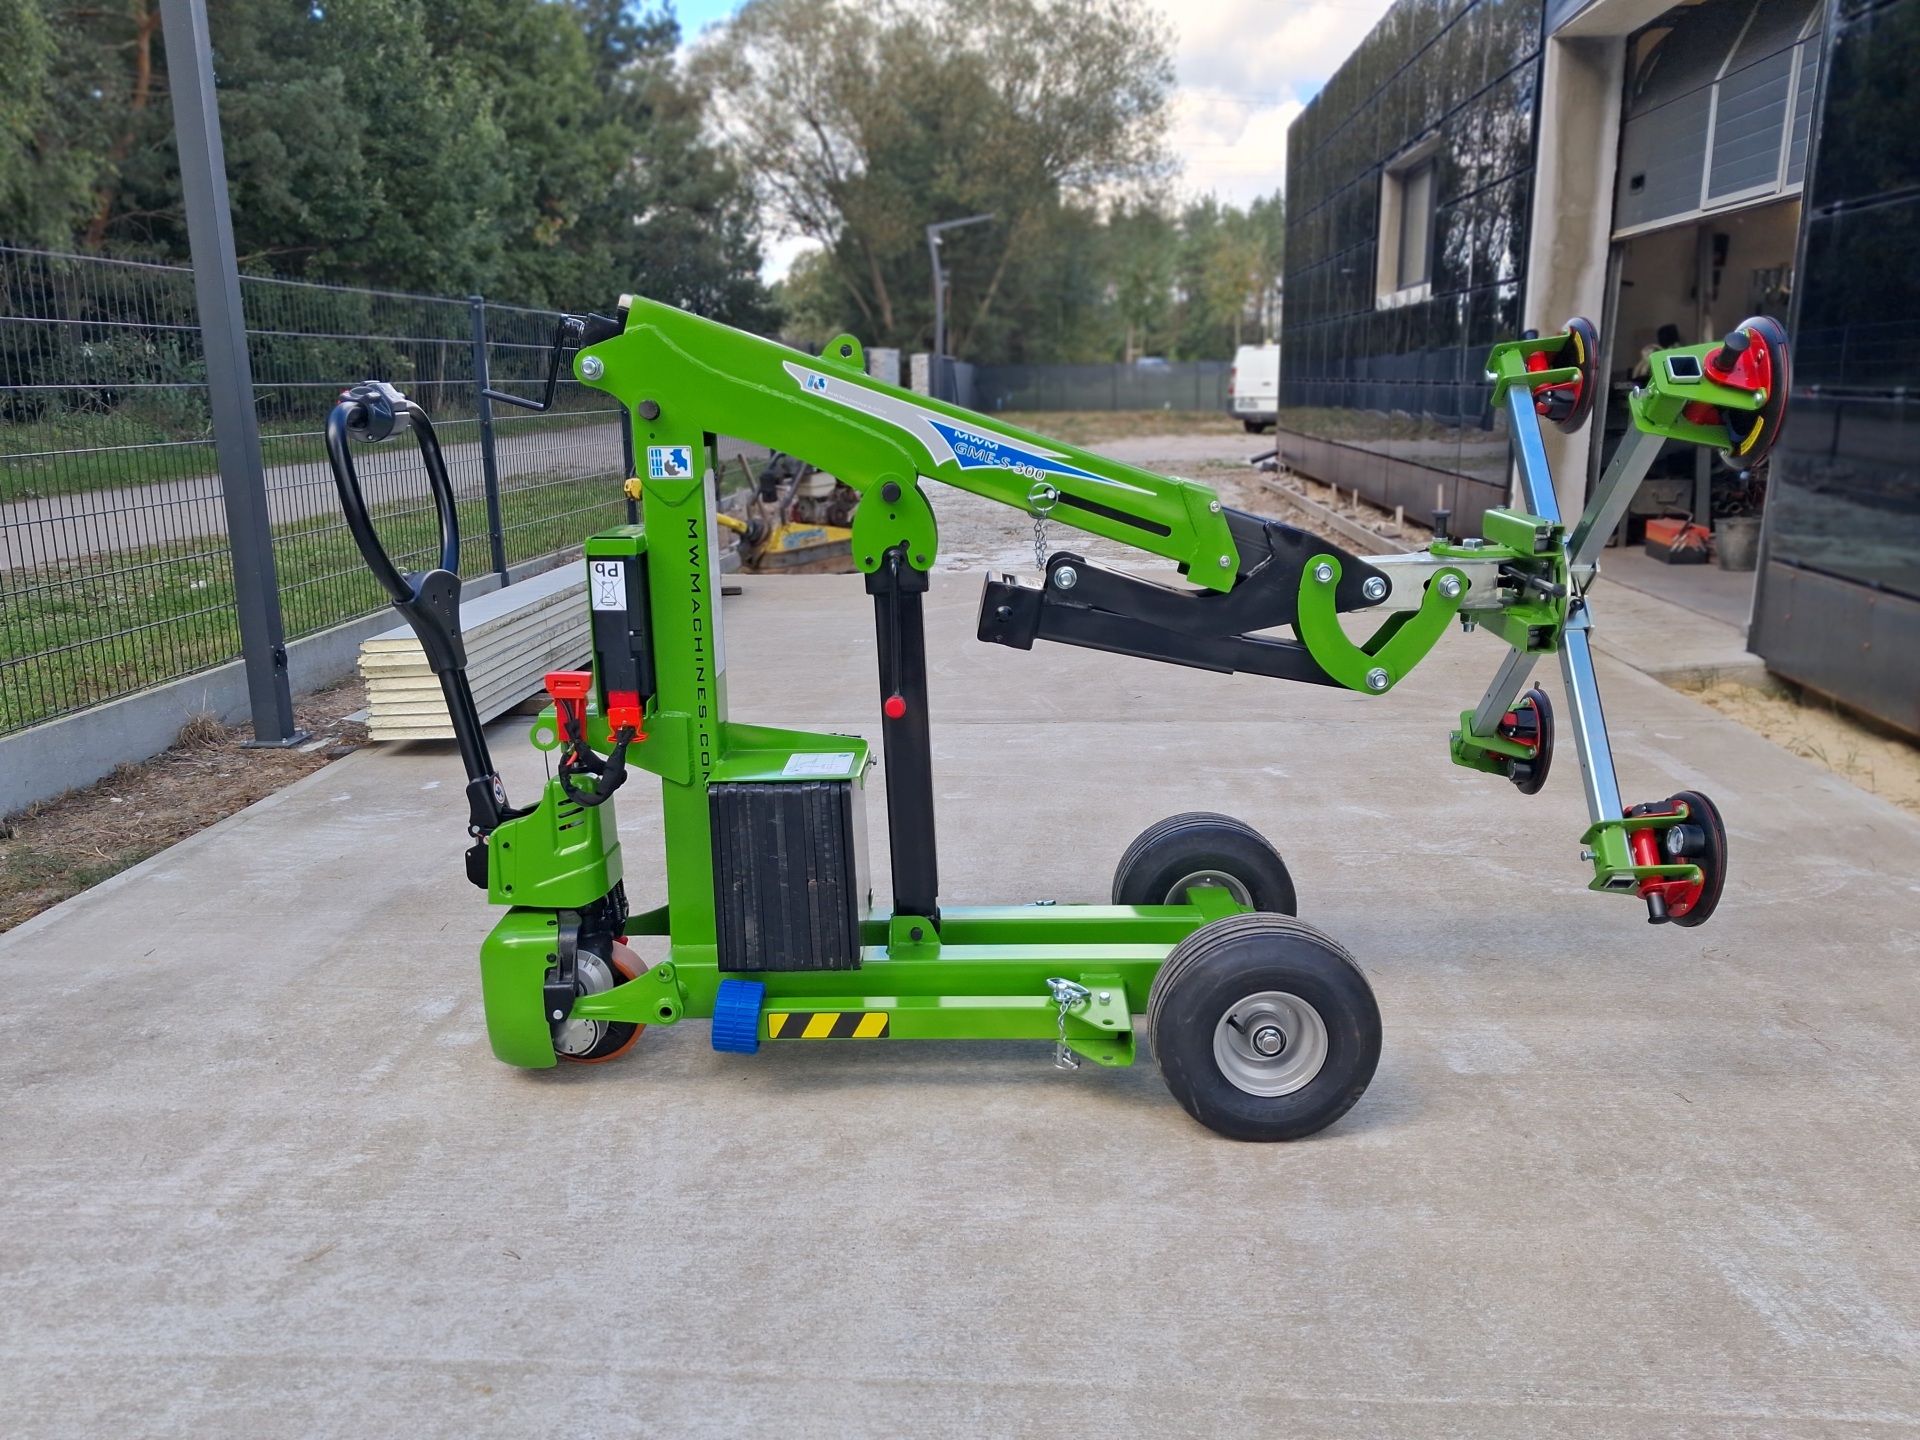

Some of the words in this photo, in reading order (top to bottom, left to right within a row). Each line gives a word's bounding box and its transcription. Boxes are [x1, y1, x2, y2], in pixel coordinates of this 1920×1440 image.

[954, 430, 999, 451] MWM
[954, 441, 1011, 470] GME-S
[1013, 461, 1046, 481] 300
[595, 562, 619, 577] Pb
